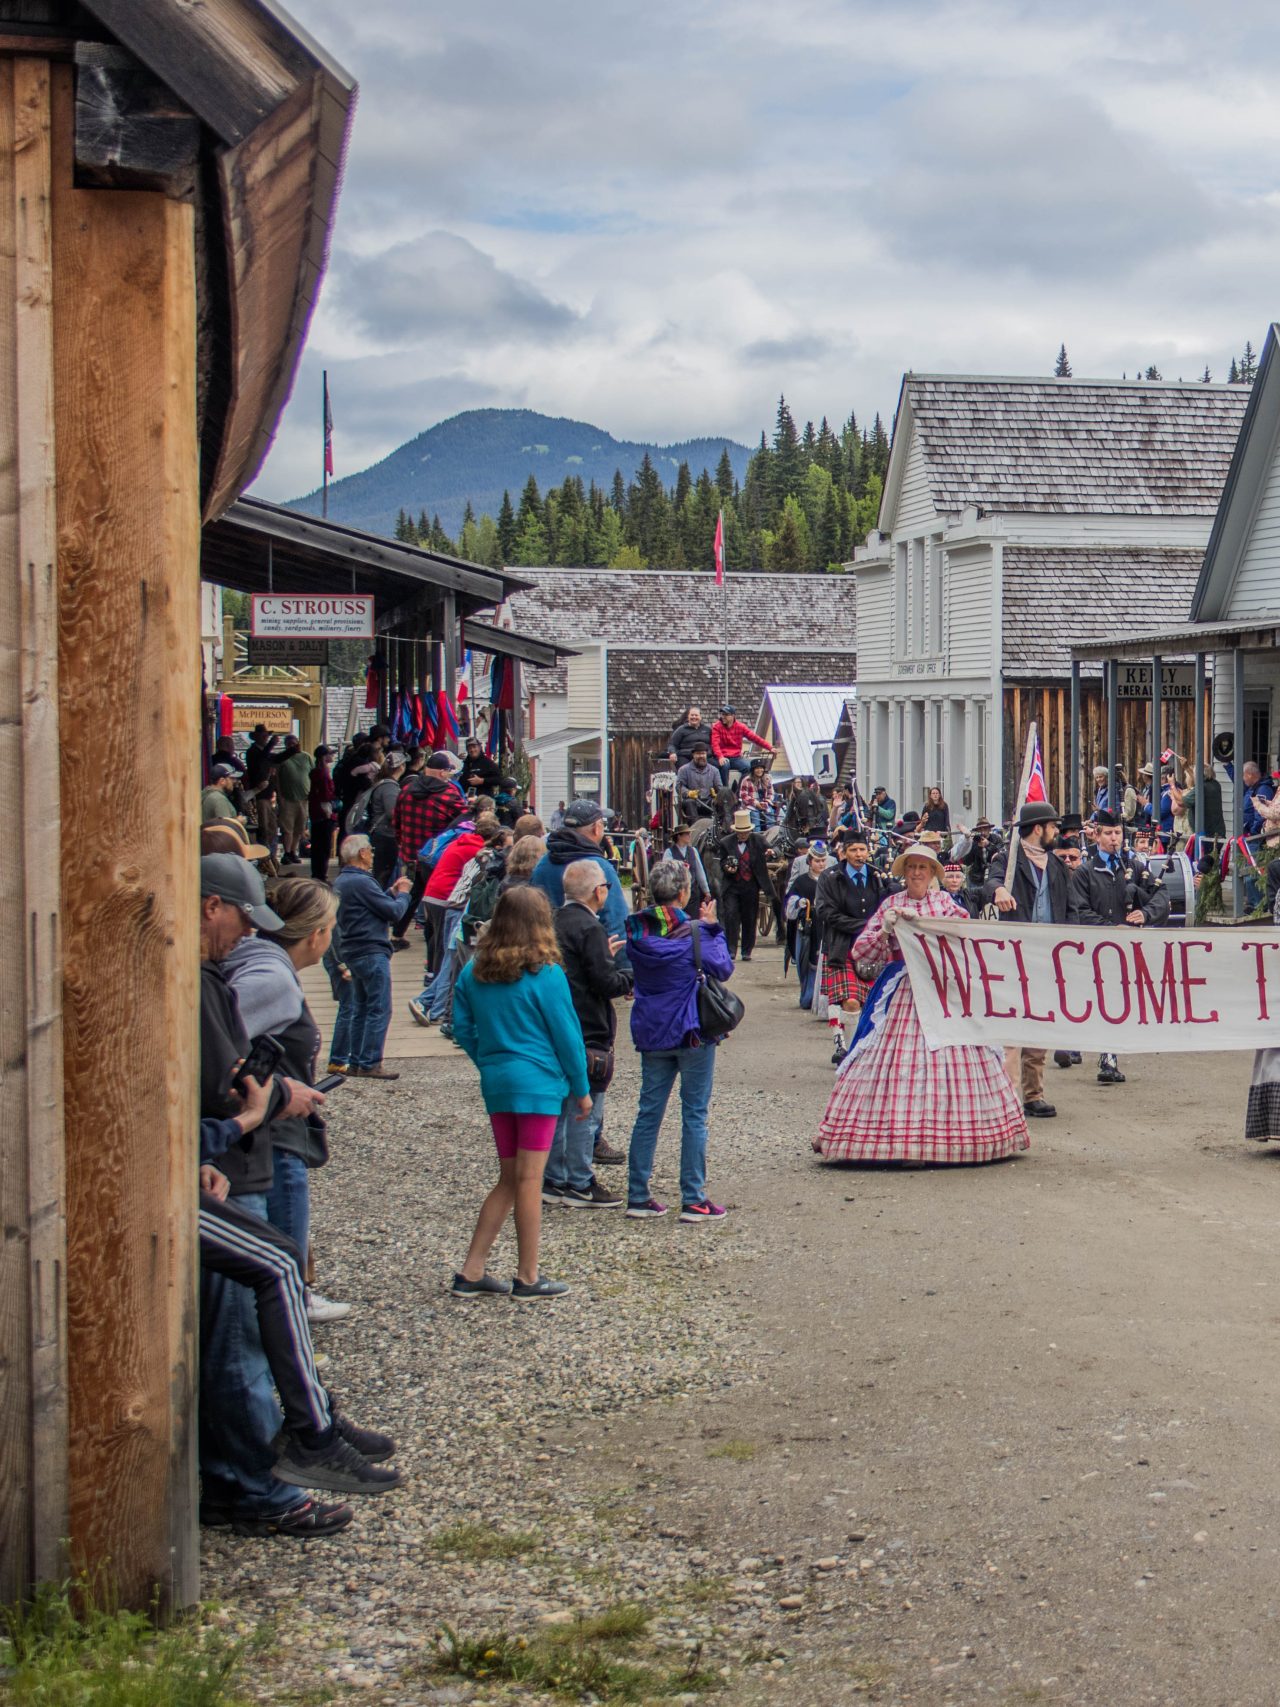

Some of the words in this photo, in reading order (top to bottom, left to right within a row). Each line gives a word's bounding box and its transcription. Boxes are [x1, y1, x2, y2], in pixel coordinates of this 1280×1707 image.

[260, 600, 276, 615] C.
[281, 600, 366, 615] STROUSS
[261, 617, 281, 625] mining
[283, 617, 309, 625] supplies,
[310, 617, 333, 625] general
[344, 625, 362, 633] finery
[251, 640, 287, 651] MASON
[289, 641, 296, 651] &
[299, 641, 325, 651] DALY
[1118, 685, 1154, 696] ENERAL
[1161, 685, 1193, 696] STORE
[239, 710, 289, 719] McPHERSON
[913, 933, 1219, 1025] WELCOME
